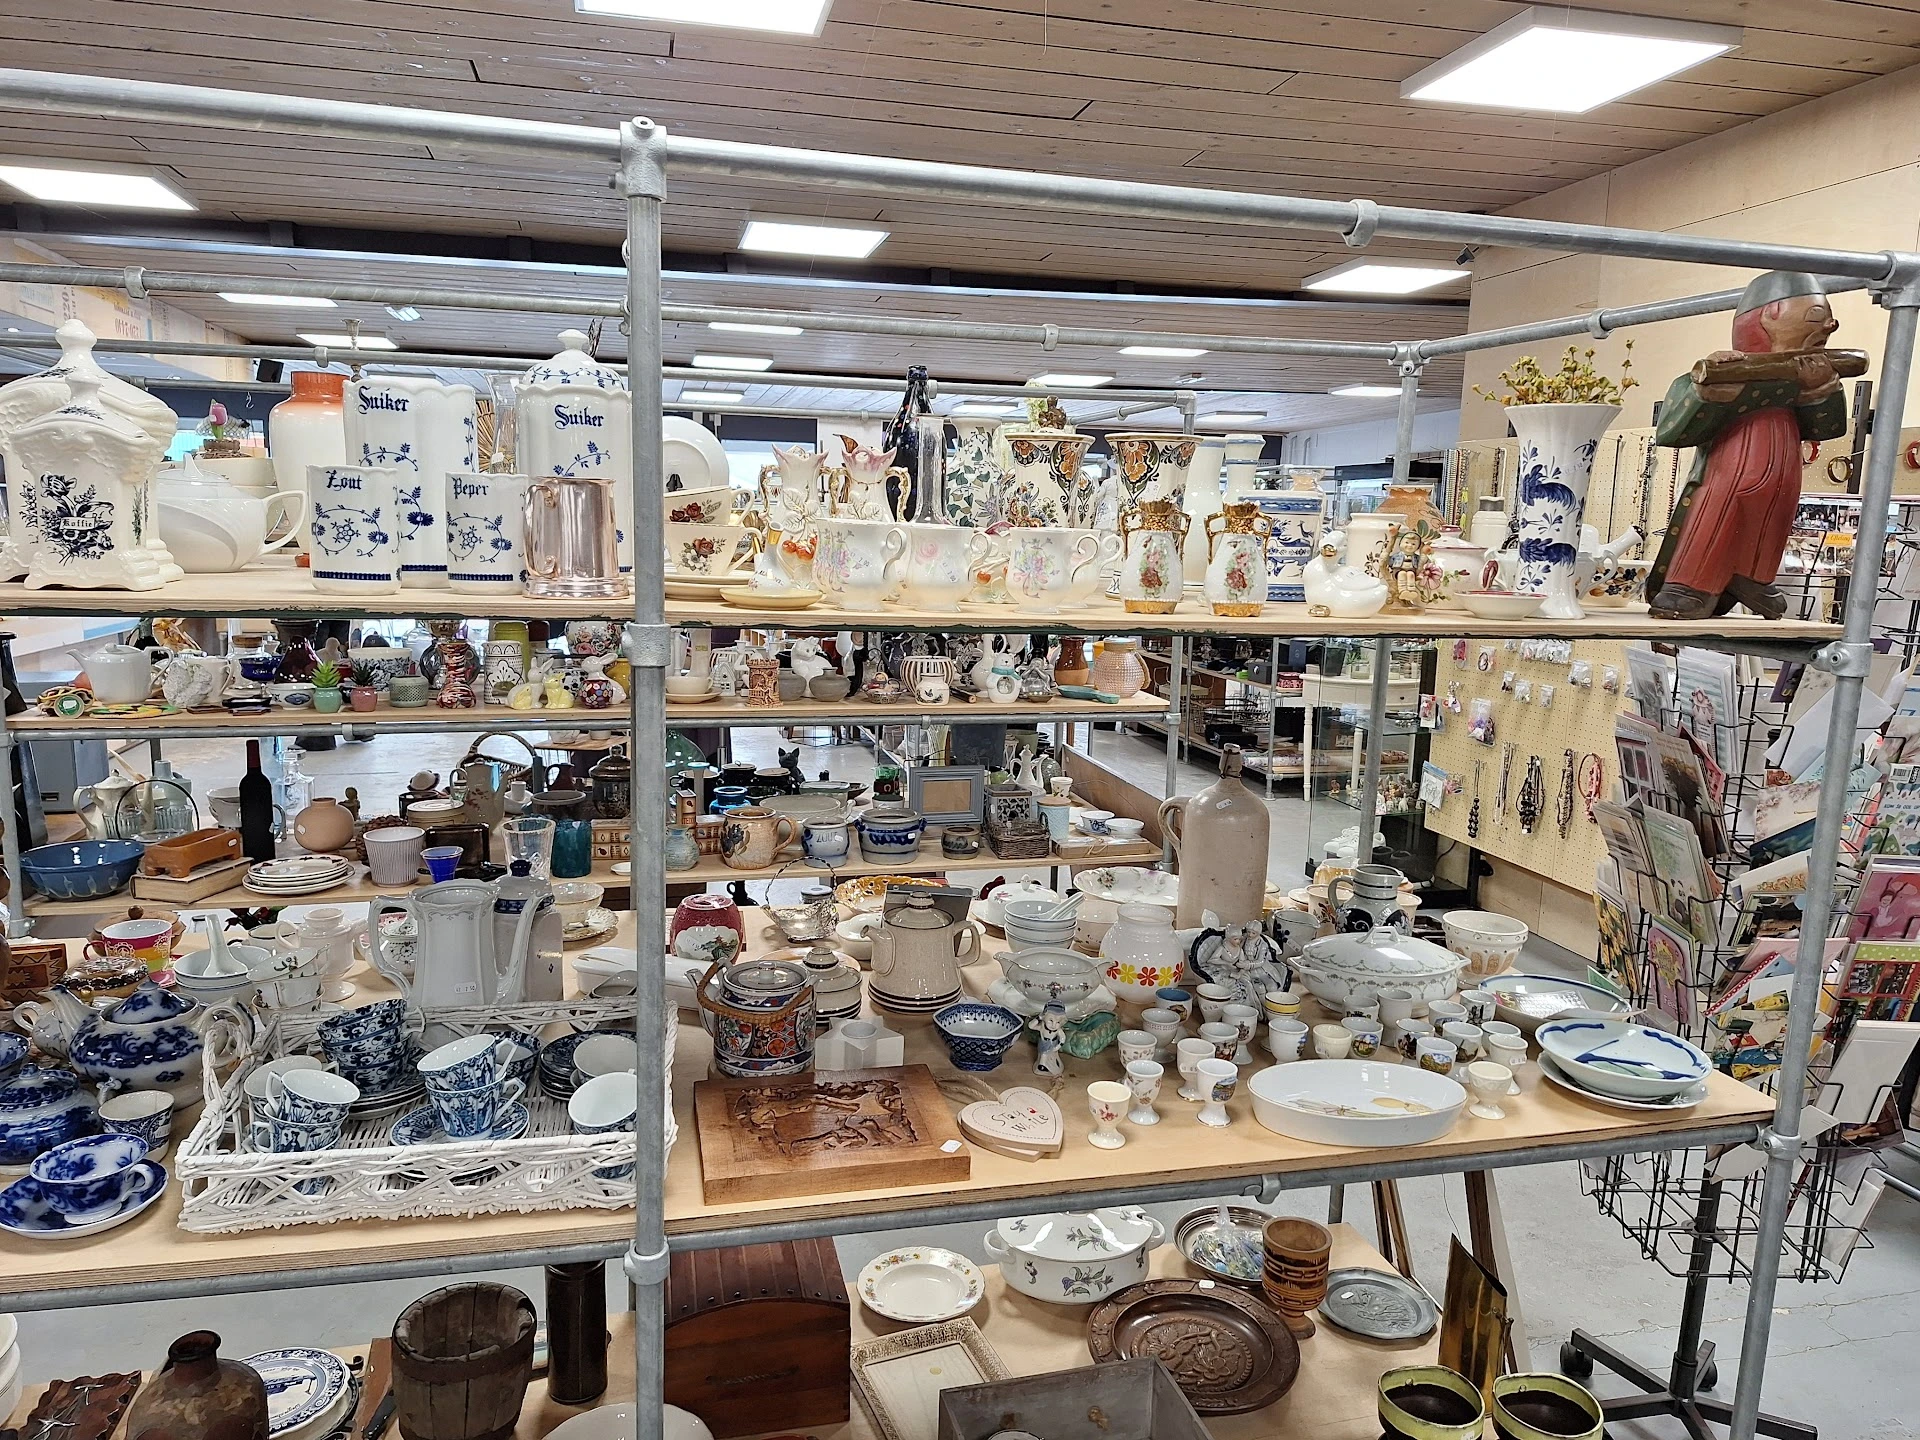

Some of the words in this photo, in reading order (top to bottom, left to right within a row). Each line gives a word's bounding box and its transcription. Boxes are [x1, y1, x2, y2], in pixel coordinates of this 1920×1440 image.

[358, 386, 409, 414] Suiker
[555, 404, 604, 430] Suiker
[325, 469, 362, 491] Zout
[451, 476, 489, 499] Peper
[62, 518, 93, 528] Koffie
